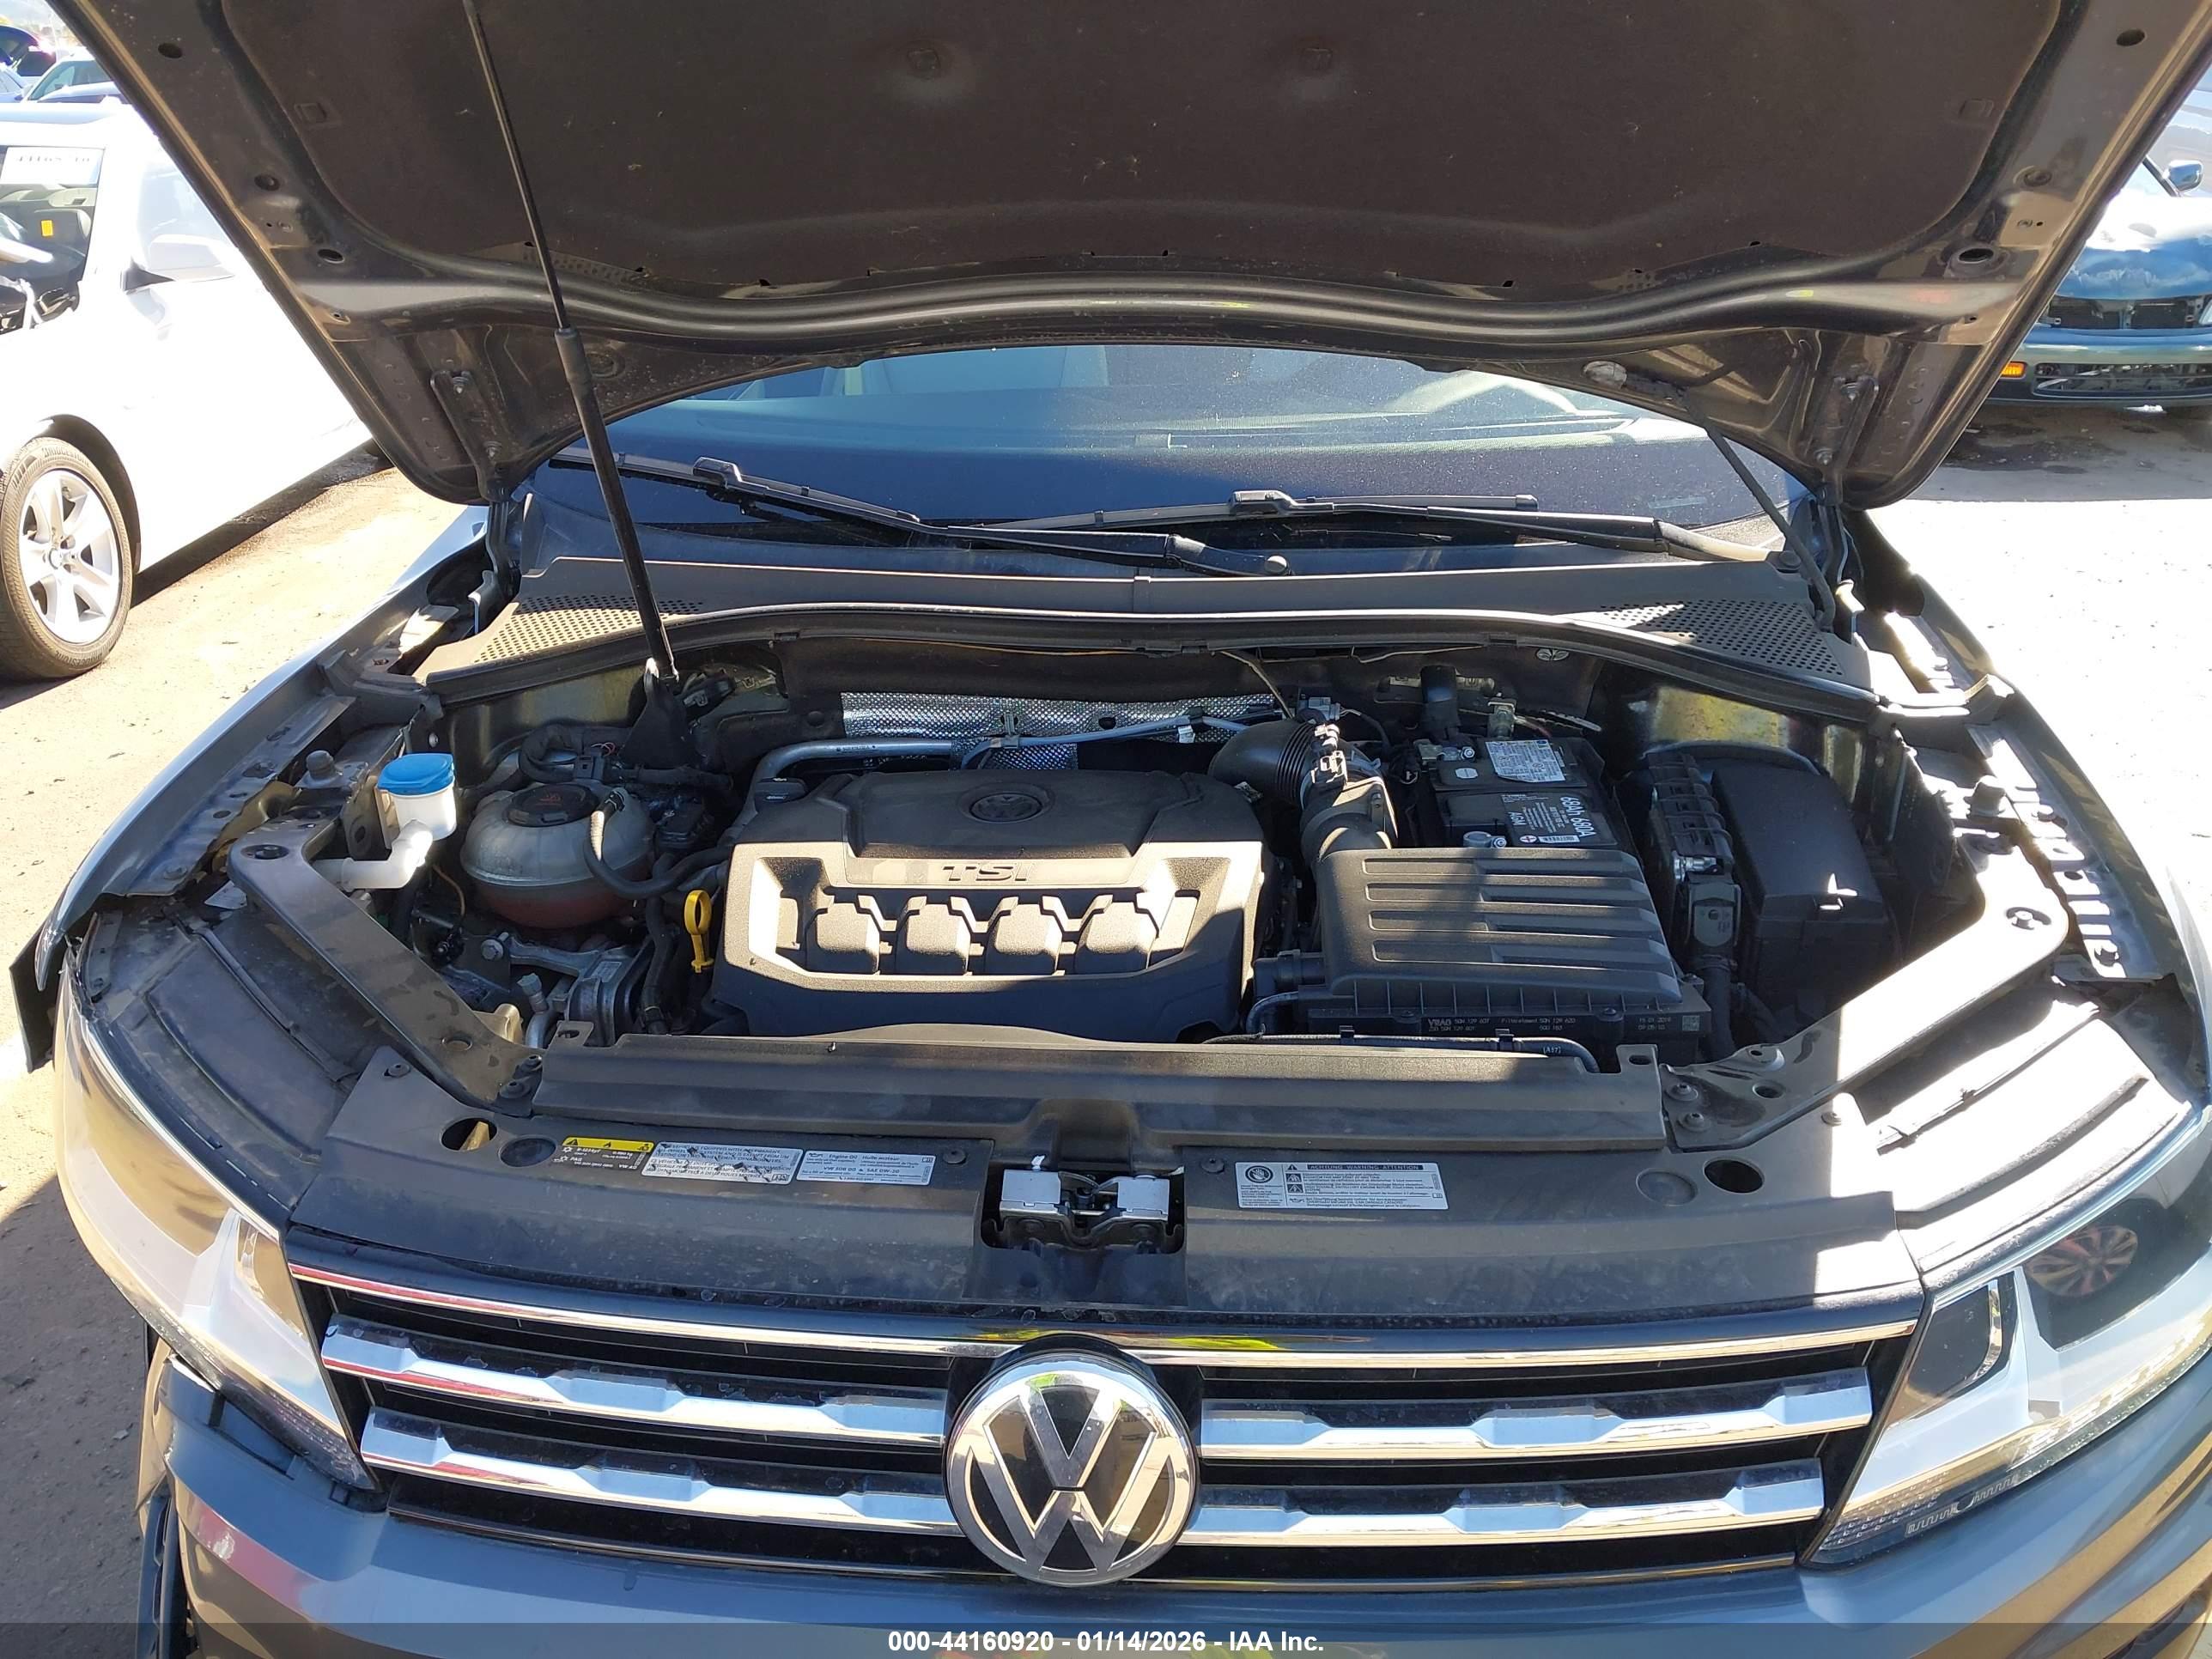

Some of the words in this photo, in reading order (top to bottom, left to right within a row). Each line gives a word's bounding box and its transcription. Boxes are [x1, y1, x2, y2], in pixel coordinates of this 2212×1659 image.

[1560, 797, 1586, 816] 68Ah
[1508, 811, 1527, 825] AGM
[1570, 817, 1596, 837] 680A
[942, 865, 1033, 882] TSI
[951, 1359, 1189, 1581] VW
